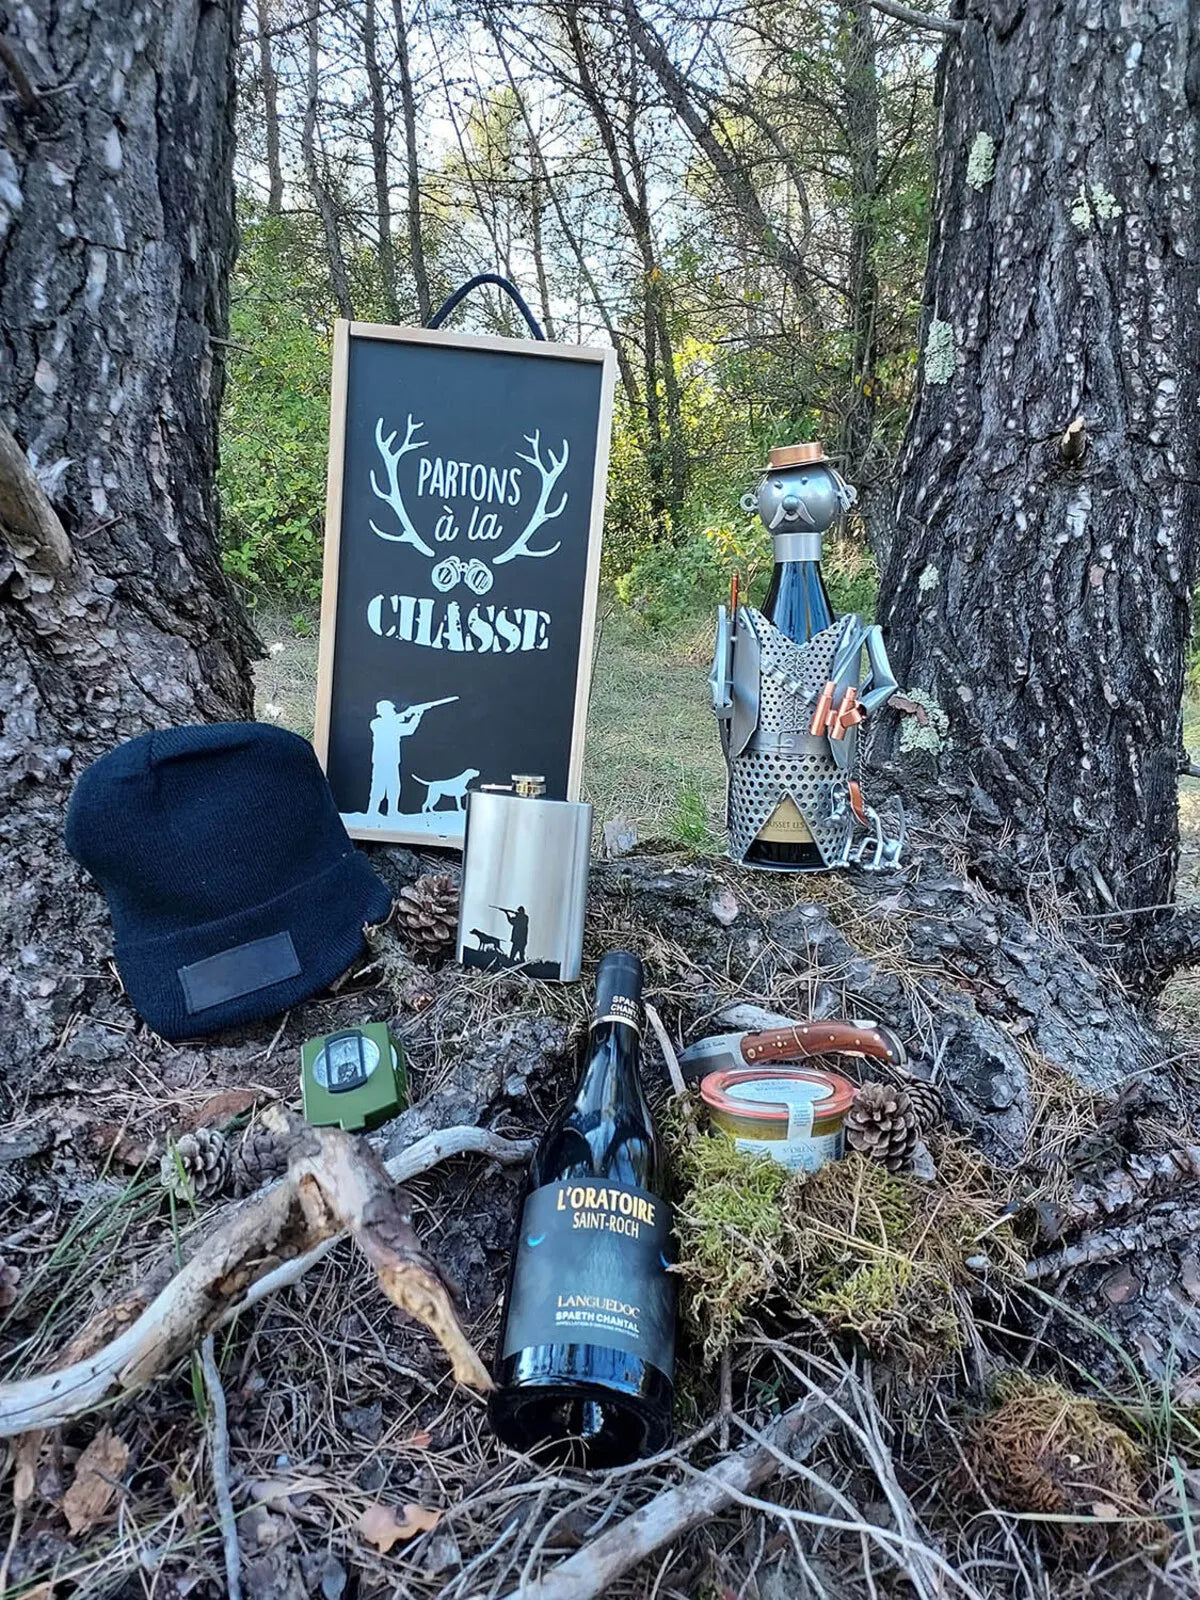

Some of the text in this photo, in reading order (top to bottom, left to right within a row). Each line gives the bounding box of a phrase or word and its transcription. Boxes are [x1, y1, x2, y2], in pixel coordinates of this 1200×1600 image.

[417, 457, 522, 506] PARTONS
[434, 505, 503, 542] à la
[367, 594, 551, 653] CHASSE
[556, 1187, 656, 1226] L'ORATOIRE
[572, 1211, 640, 1239] SAINT-ROCH
[555, 1311, 595, 1322] SPAETH
[596, 1313, 640, 1333] CHANTAL
[557, 1295, 641, 1319] LANGUEDOC
